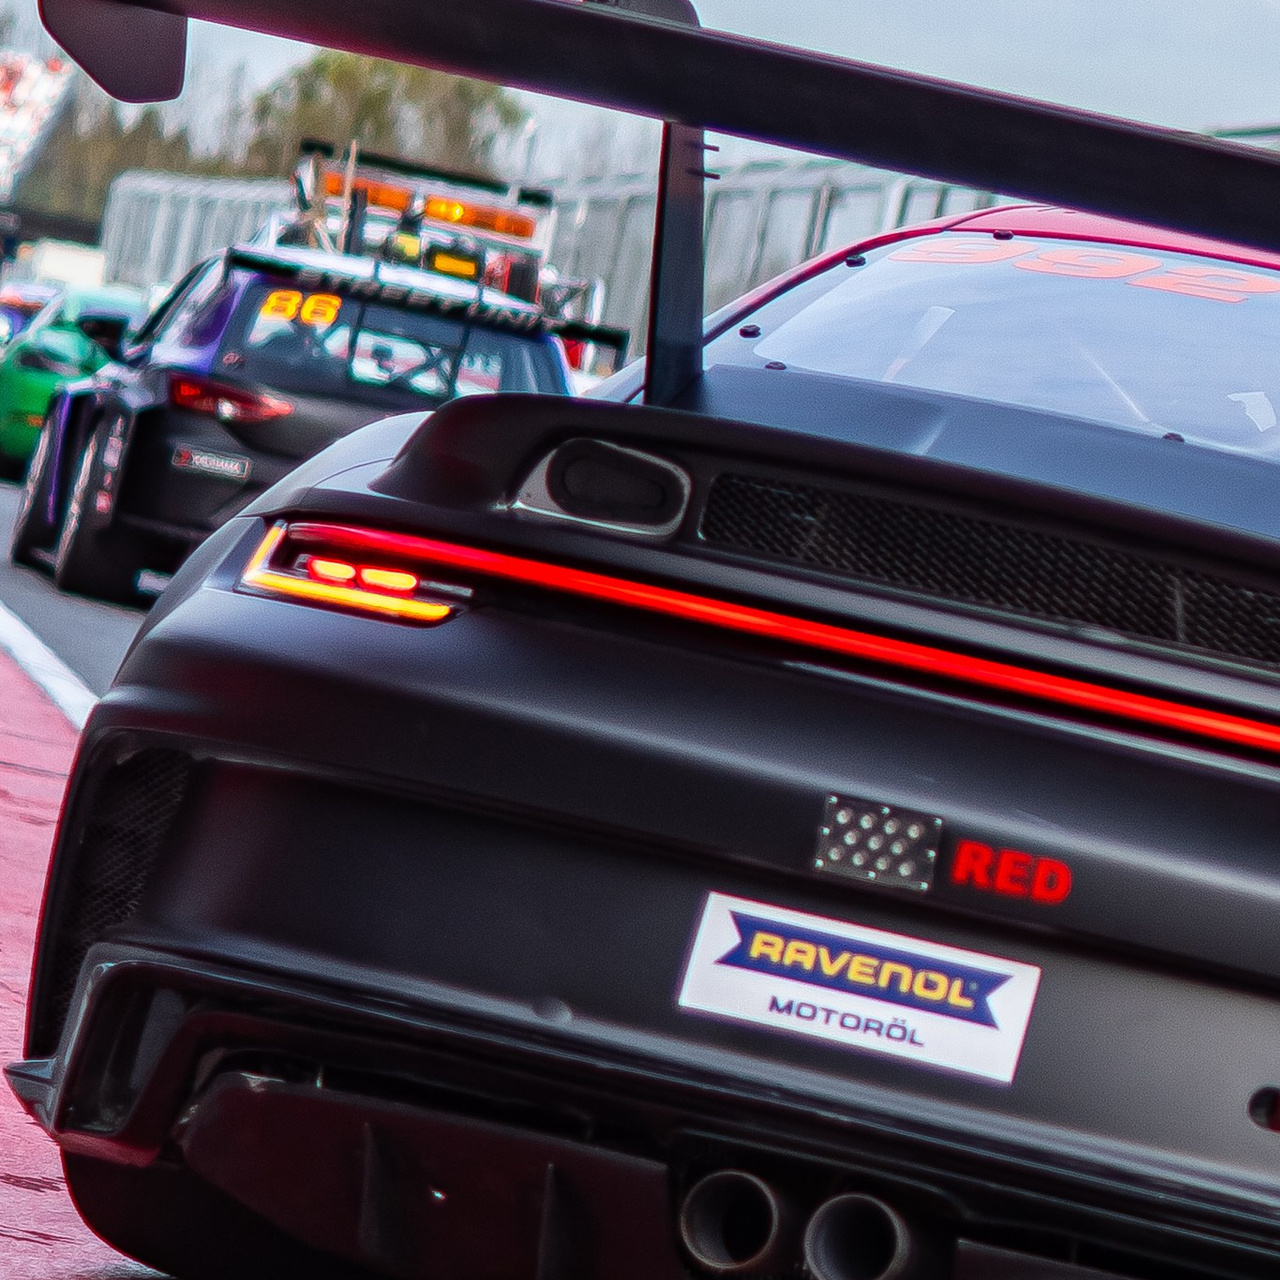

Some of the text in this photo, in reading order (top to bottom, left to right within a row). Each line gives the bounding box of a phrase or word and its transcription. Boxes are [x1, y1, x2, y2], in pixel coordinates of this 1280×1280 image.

[260, 289, 342, 325] 86
[951, 839, 1072, 904] RED
[749, 931, 975, 1010] RAVENOL
[768, 995, 925, 1048] MOTORÖL
